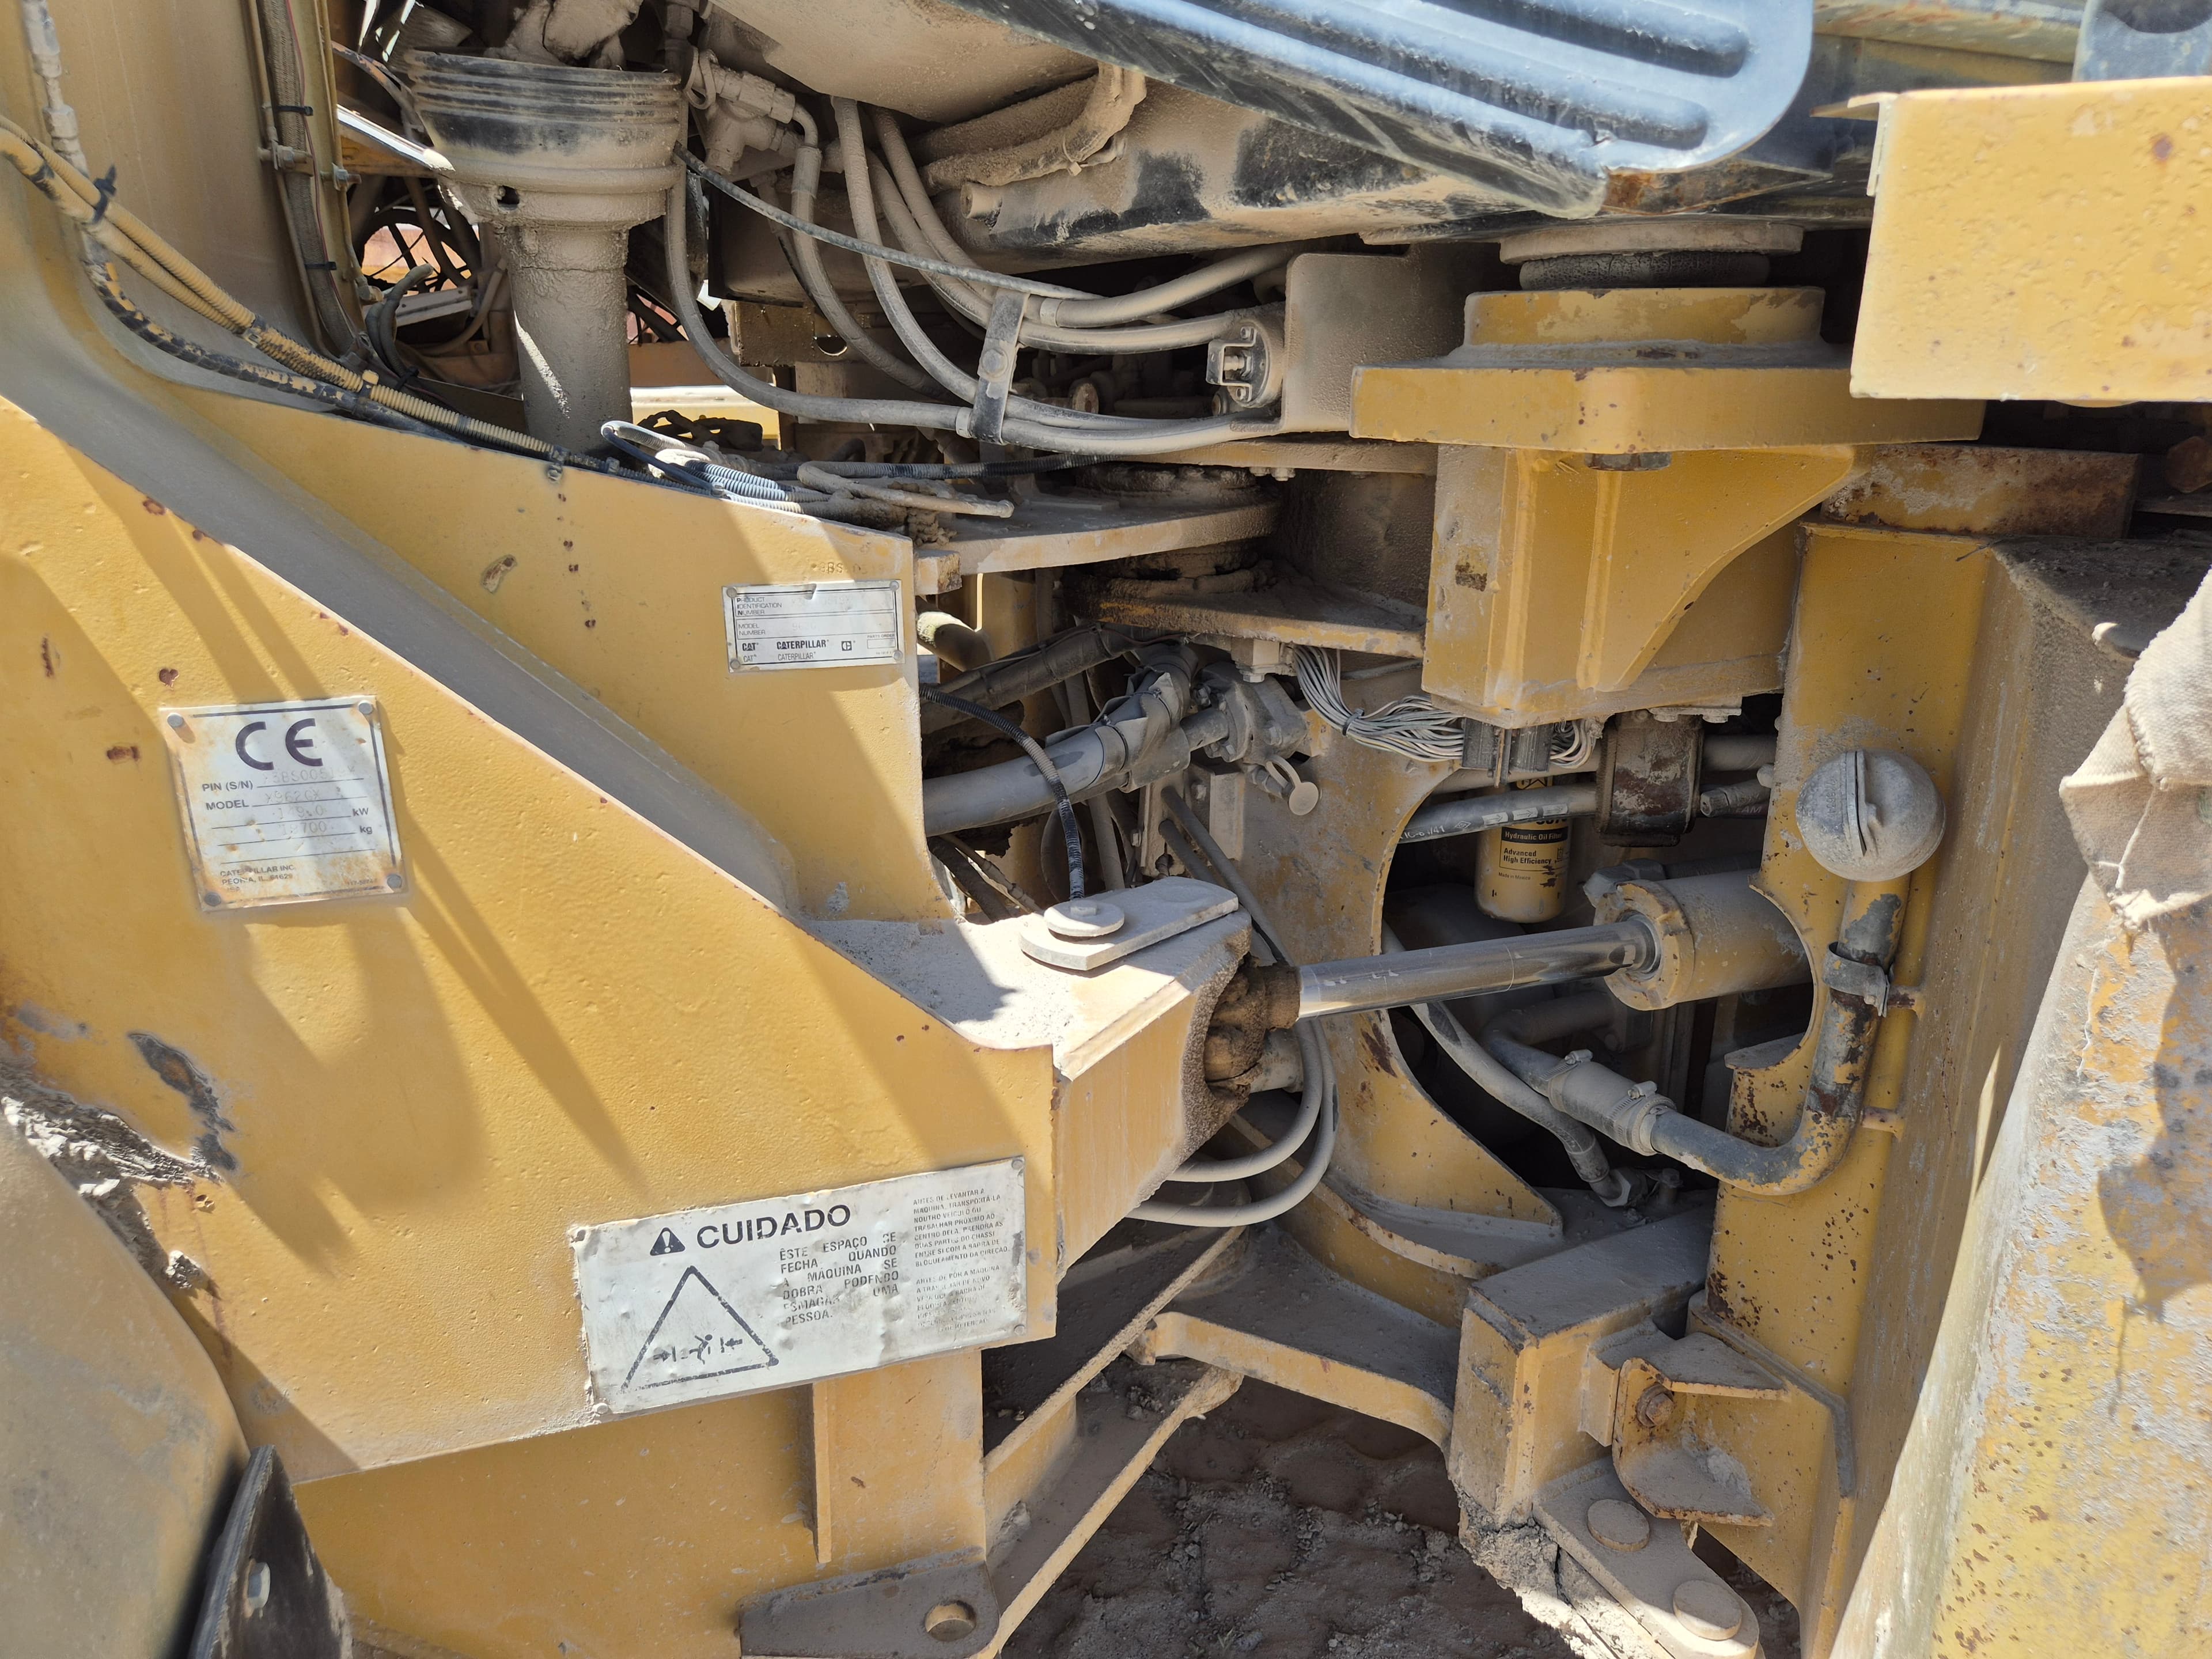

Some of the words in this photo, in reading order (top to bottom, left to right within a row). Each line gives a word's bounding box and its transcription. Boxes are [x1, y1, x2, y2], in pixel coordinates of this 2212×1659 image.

[777, 640, 826, 650] CATERPILLAR
[778, 652, 814, 661] CATERPILLAR
[236, 718, 323, 771] CE
[202, 783, 222, 791] PIN
[225, 780, 253, 791] (S/N)
[206, 800, 249, 810] MODEL
[353, 808, 369, 816] kW
[359, 825, 373, 835] kg
[1505, 831, 1537, 840] Hydraulic
[1503, 847, 1537, 857] Advanced
[1503, 855, 1518, 863] High
[914, 1213, 941, 1223] NOUTRO
[696, 1205, 851, 1249] CUIDADO
[823, 1236, 868, 1253] ESPAÇO
[781, 1258, 819, 1274] FECHA
[849, 1245, 896, 1262] QUANDO
[884, 1257, 898, 1270] SE
[783, 1285, 823, 1300] DOBRA
[873, 1283, 899, 1297] UMA
[785, 1309, 833, 1325] PESSOA.
